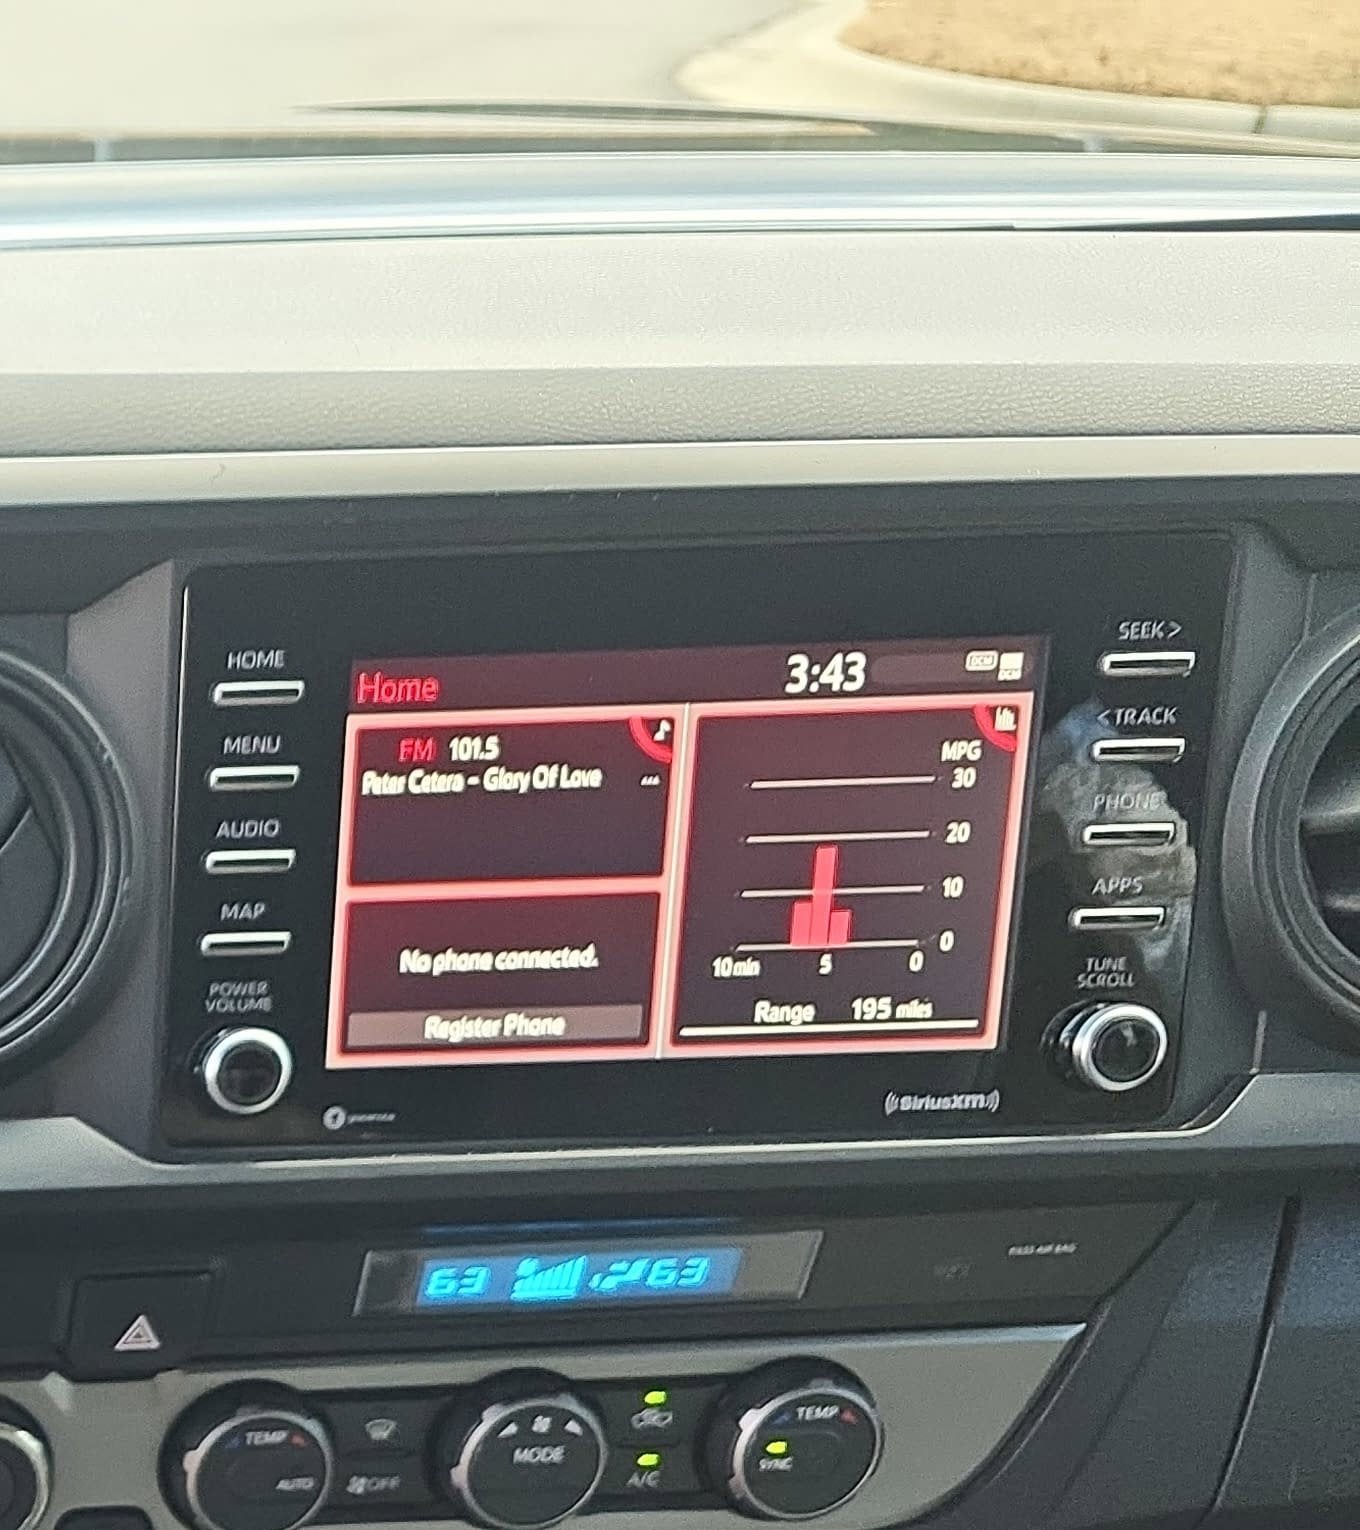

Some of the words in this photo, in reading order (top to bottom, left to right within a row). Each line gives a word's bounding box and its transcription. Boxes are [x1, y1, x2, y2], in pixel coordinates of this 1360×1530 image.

[227, 650, 285, 669] HOME
[785, 652, 868, 693] 3:43
[357, 672, 440, 703] Home
[1114, 706, 1177, 727] TRACK
[223, 735, 280, 755] MENU
[398, 739, 436, 763] FM
[449, 737, 500, 761] 101.5
[941, 740, 982, 763] MPG
[362, 771, 405, 796] Peter
[407, 770, 465, 793] Cetera
[483, 768, 530, 795] Glory
[533, 767, 558, 791] Of
[560, 766, 602, 789] Love
[951, 767, 976, 789] 30
[1092, 792, 1162, 812] PHONE
[215, 819, 280, 839] AUDIO
[945, 822, 970, 845] 20
[942, 877, 964, 899] 10
[1092, 876, 1144, 896] APPS
[220, 902, 266, 921] MAP
[939, 931, 955, 952] 0
[399, 949, 430, 973] No
[432, 946, 493, 978] phone
[495, 943, 599, 972] connected.
[818, 954, 833, 976] 5
[908, 951, 925, 973] 0
[208, 981, 268, 998] POWER
[204, 996, 272, 1013] VOLUME
[754, 1001, 816, 1025] Range
[850, 998, 891, 1020] 195
[895, 998, 933, 1019] miles
[425, 1014, 501, 1042] Register
[503, 1013, 566, 1038] Phone
[425, 1266, 495, 1297] 63
[646, 1255, 713, 1290] 63
[797, 1405, 840, 1421] TEMP
[245, 1430, 288, 1447] TEMP
[513, 1446, 566, 1465] MODE
